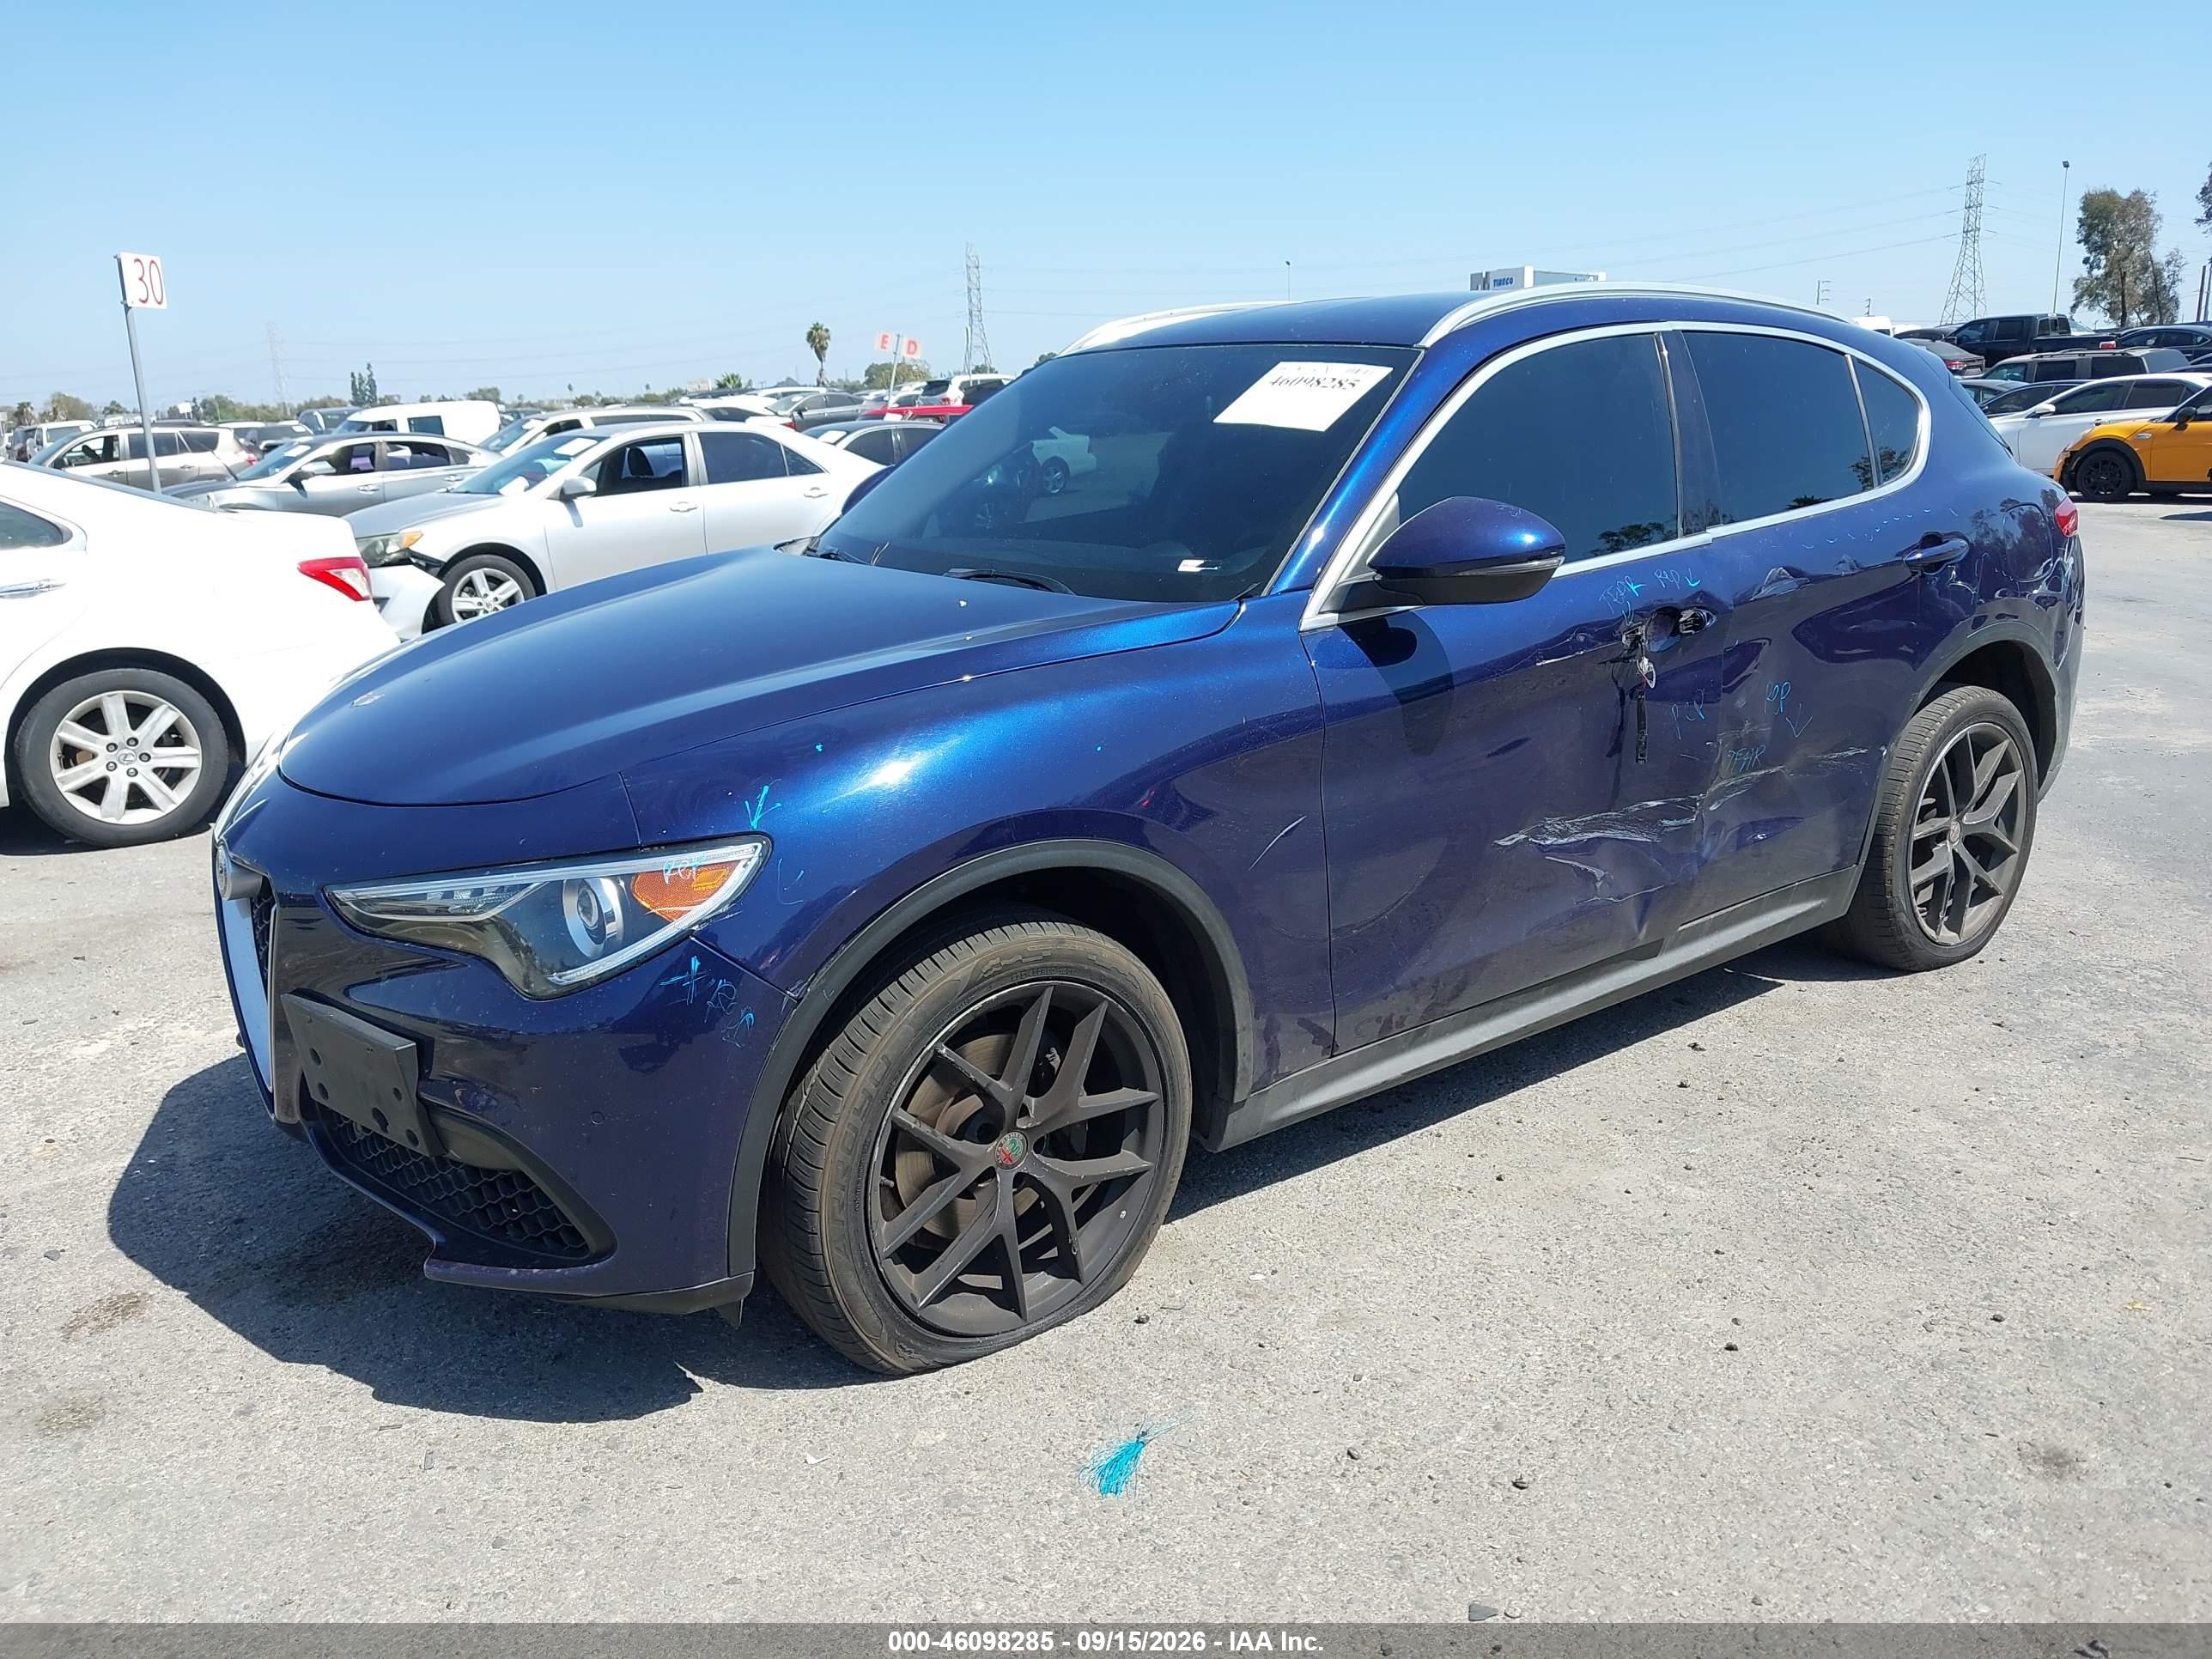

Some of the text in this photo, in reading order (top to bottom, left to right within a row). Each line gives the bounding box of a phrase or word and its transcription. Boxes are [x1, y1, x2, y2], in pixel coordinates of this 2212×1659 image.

[133, 258, 164, 305] 30
[880, 334, 890, 349] E
[906, 340, 918, 355] D
[1268, 374, 1362, 391] 46098285
